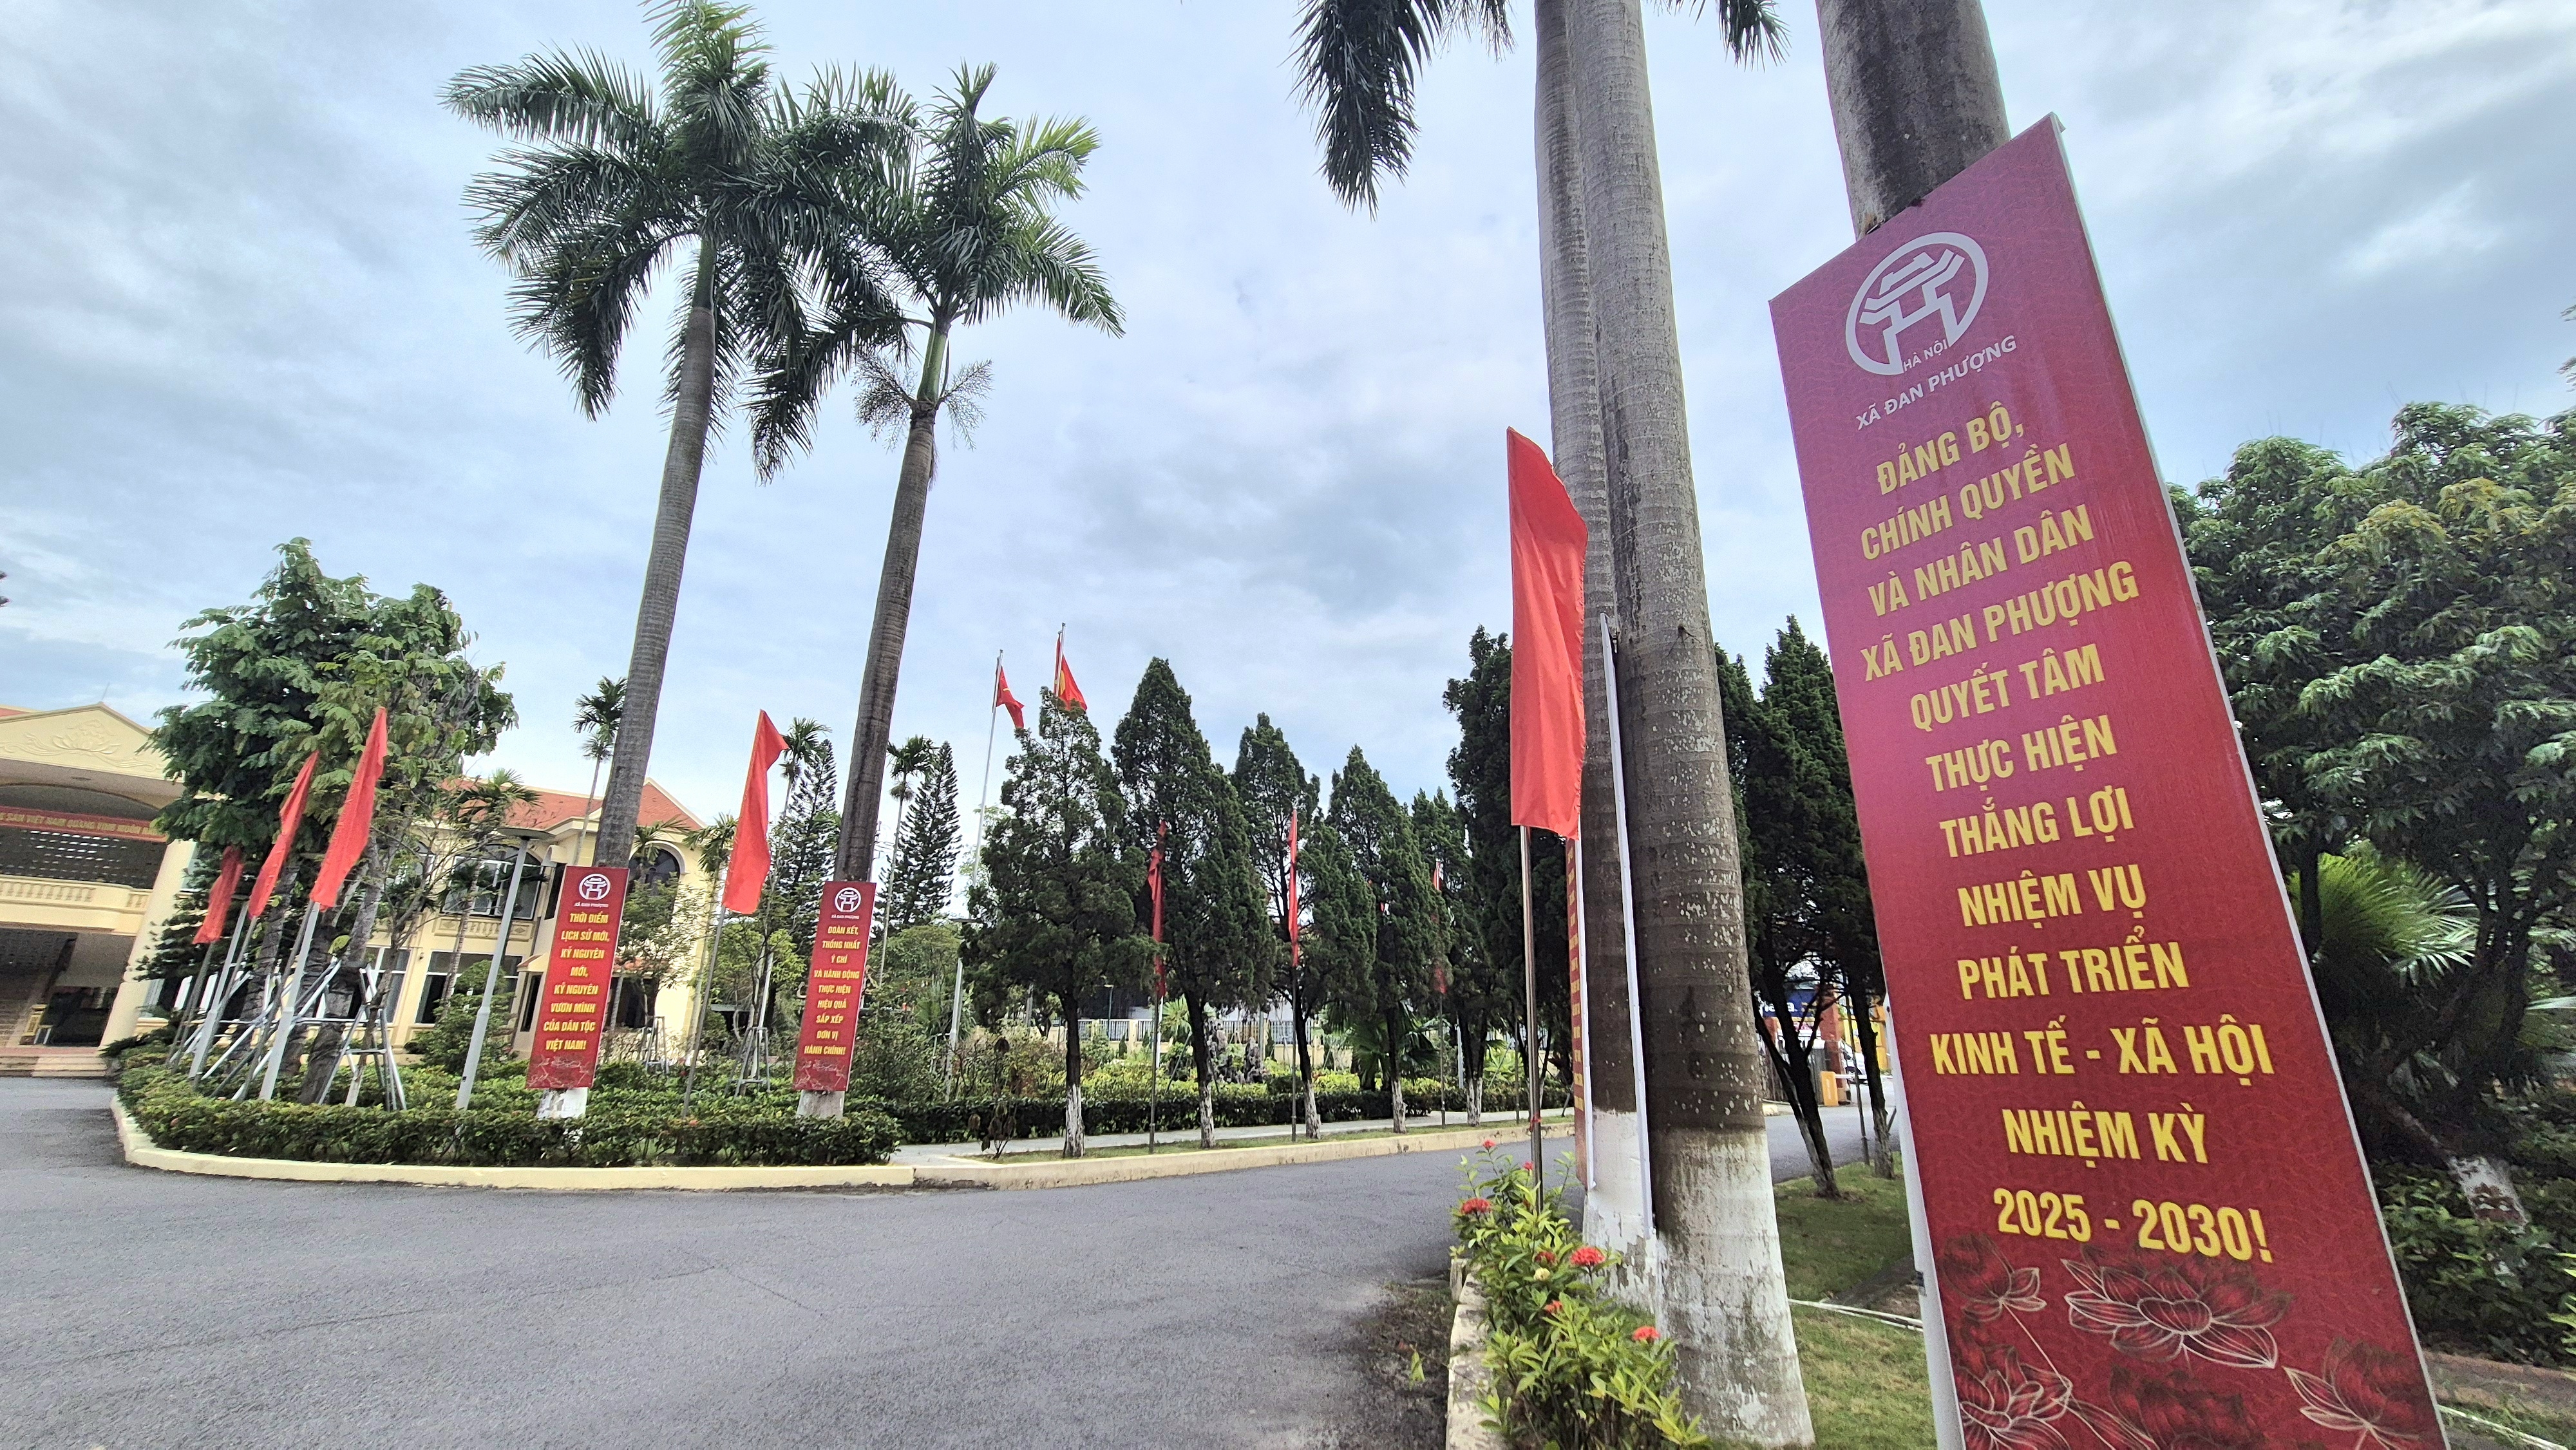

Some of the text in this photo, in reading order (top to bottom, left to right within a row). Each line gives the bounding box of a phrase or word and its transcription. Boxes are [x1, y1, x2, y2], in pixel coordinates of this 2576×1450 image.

[1856, 335, 2017, 430] XÃ ĐAN PHƯỢNG
[1903, 338, 1948, 372] HÀ NỘI
[1876, 400, 2024, 495] ĐẢNG BỘ,
[1861, 443, 2076, 560] CHÍNH QUYỀN
[1868, 504, 2095, 617] VÀ NHÂN DÂN
[1861, 560, 2139, 681] XÃ ĐAN PHƯỢNG
[1910, 643, 2105, 732] QUYẾT TÂM
[1926, 715, 2117, 792] THỰC HIỆN
[1939, 784, 2134, 858] THẮNG LỢI
[1957, 863, 2146, 928] NHIỆM VỤ
[1957, 925, 2189, 1000] PHÁT TRIỂN
[1929, 1031, 2019, 1075] KINH
[2024, 1015, 2075, 1075] TẾ
[2109, 1017, 2178, 1075] XÃ
[2183, 1013, 2275, 1086] HỘI
[2002, 1100, 2208, 1168] NHIỆM KỲ
[1994, 1187, 2091, 1242] 2025
[2132, 1198, 2273, 1263] 2030!
